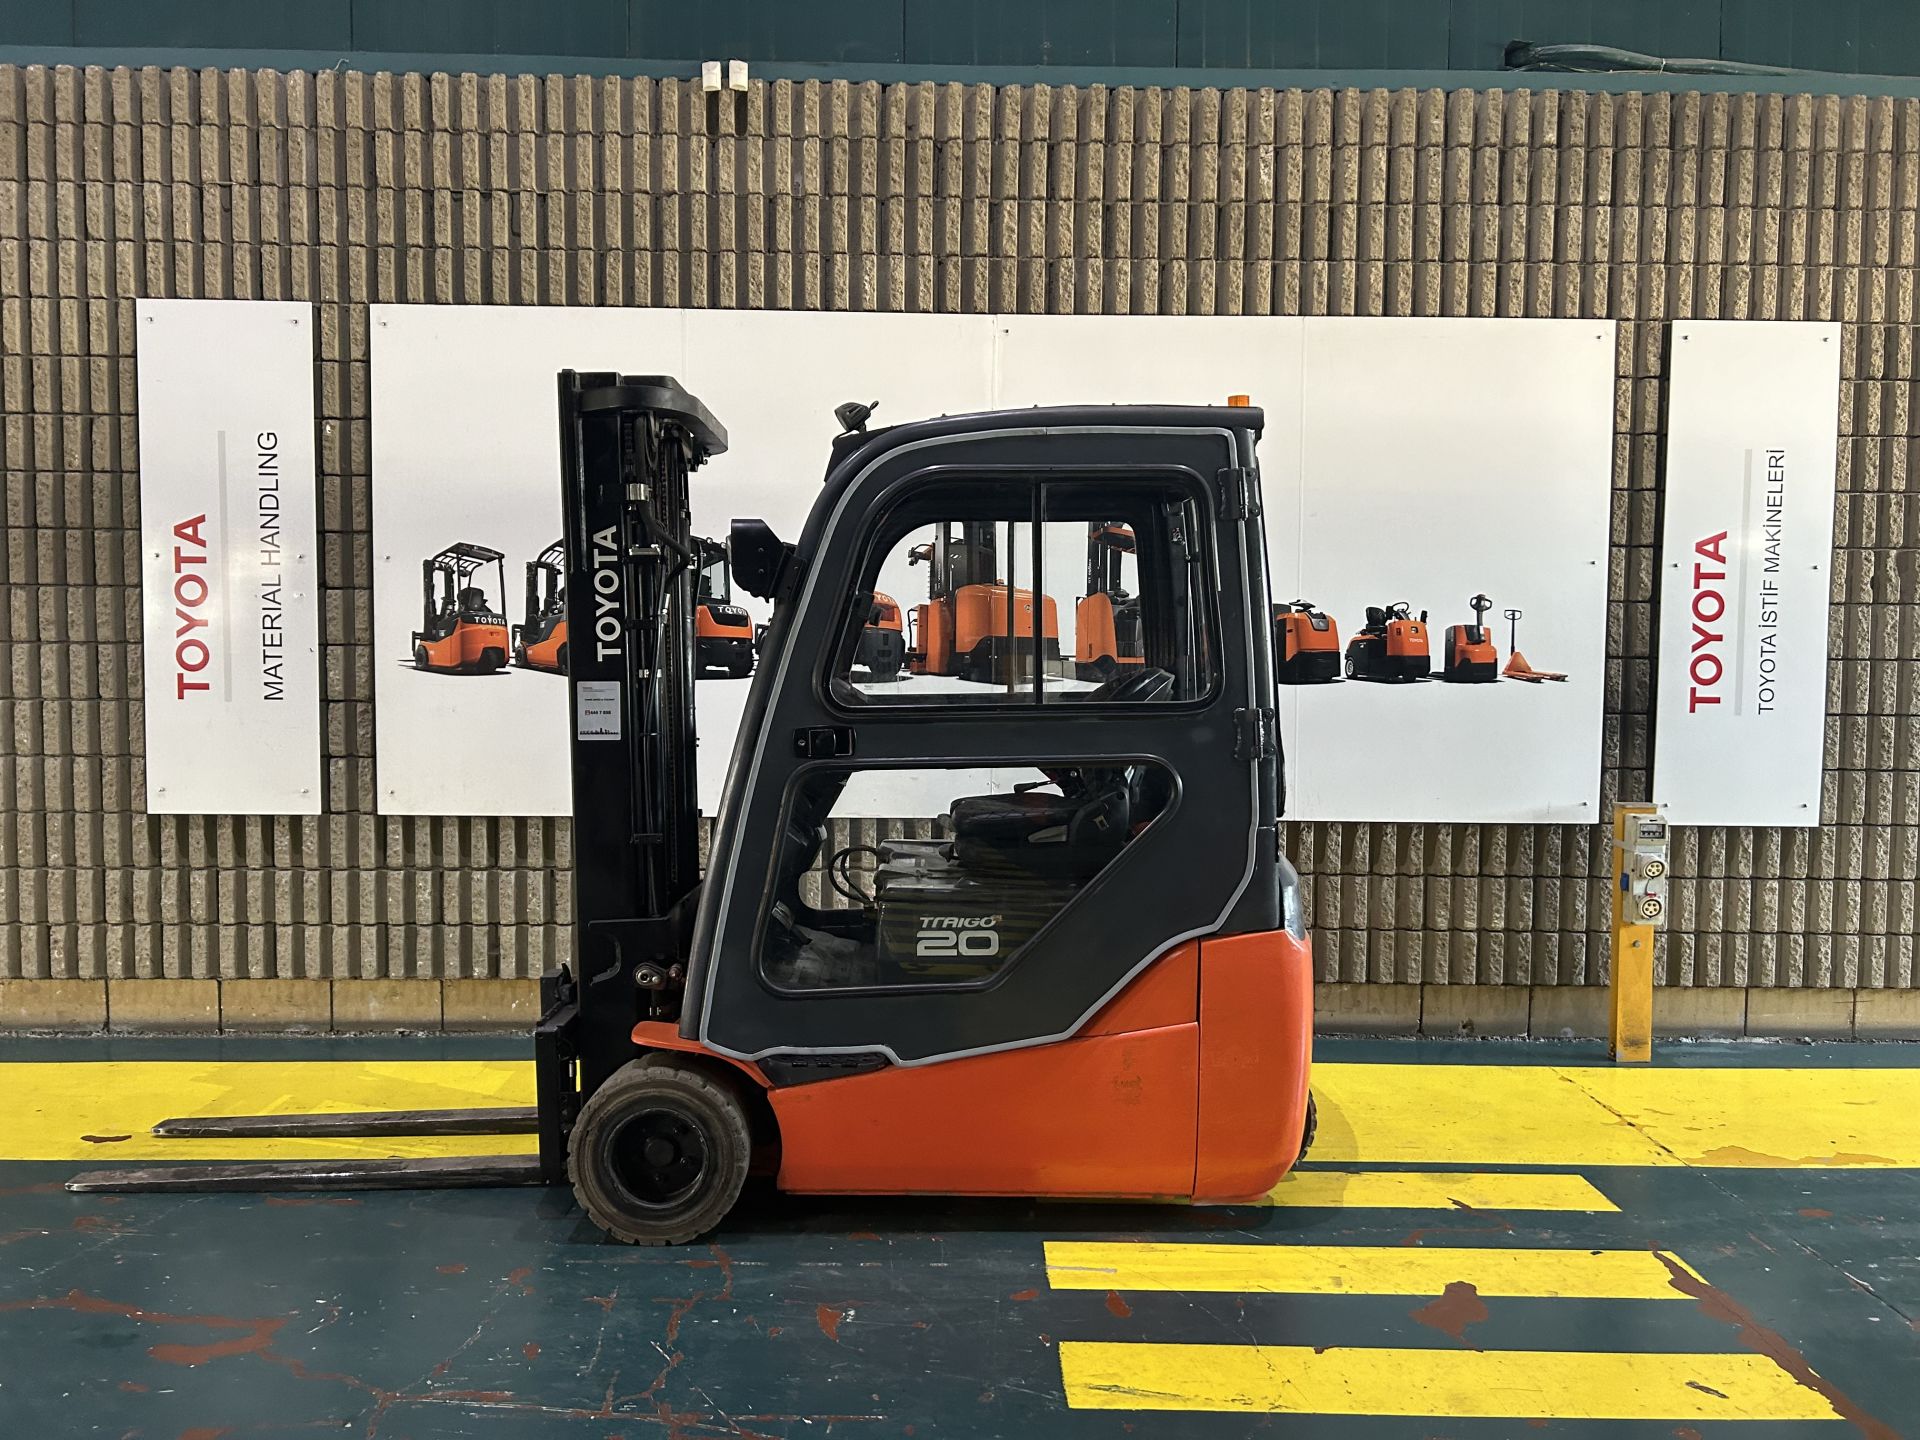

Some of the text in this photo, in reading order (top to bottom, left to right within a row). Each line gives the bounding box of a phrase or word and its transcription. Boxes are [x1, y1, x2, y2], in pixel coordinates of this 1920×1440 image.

[173, 514, 210, 700] TOYOTA
[257, 432, 284, 701] MATERIAL HANDLING
[474, 615, 506, 625] TOYOTA
[592, 525, 622, 662] TOYOTA
[1688, 530, 1728, 714] TOYOTA
[1758, 449, 1785, 716] TOYOTA İSTİF MAKİNELERİ
[916, 930, 999, 957] 20
[919, 916, 996, 928] TRAIGO
